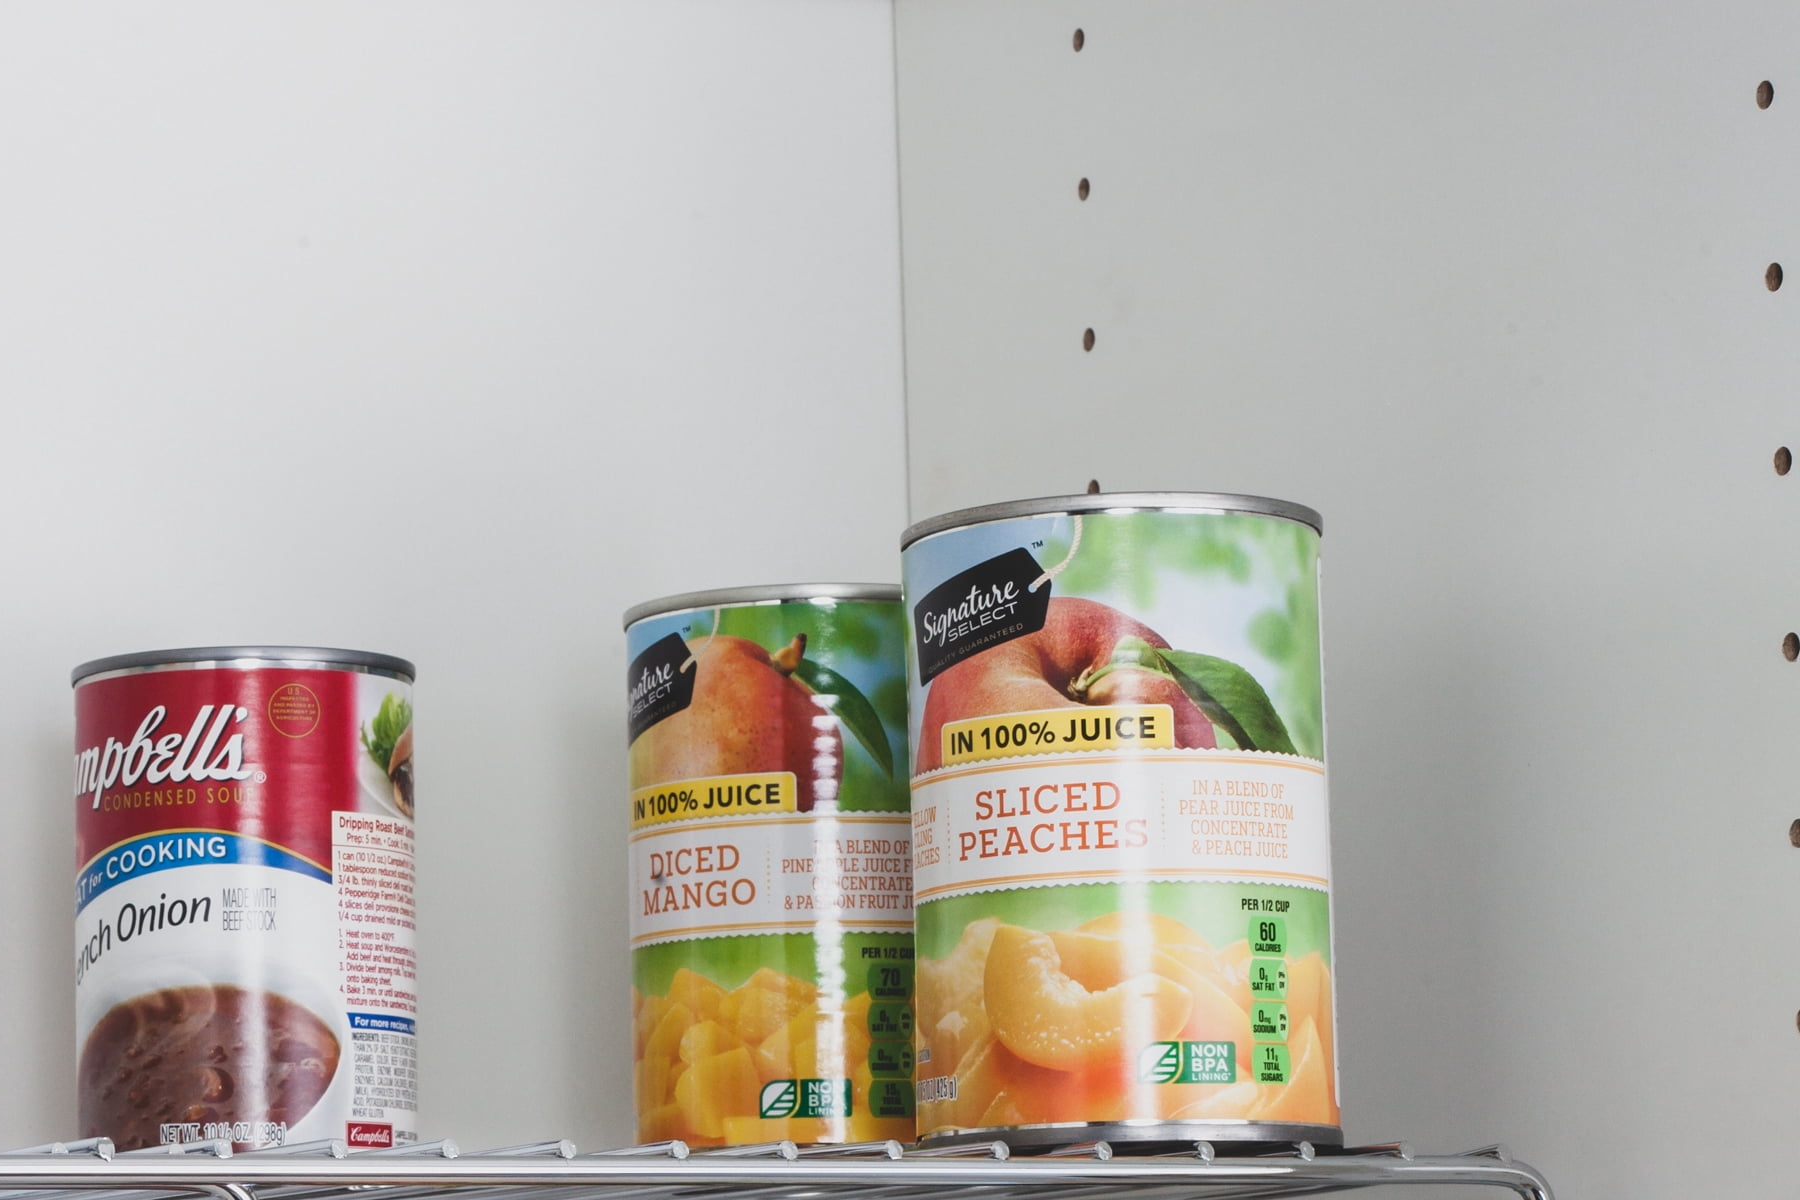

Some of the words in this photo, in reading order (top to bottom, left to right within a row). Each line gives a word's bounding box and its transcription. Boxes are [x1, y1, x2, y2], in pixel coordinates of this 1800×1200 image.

[923, 578, 1019, 648] Signature
[947, 602, 1018, 642] SELECT
[959, 623, 1024, 656] GUARANTEED
[950, 732, 974, 756] IN
[981, 721, 1055, 751] 100%
[1062, 716, 1156, 742] JUICE
[104, 789, 196, 811] CONDENSED
[634, 800, 646, 821] IN
[649, 790, 698, 815] 100%
[703, 783, 780, 809] JUICE
[975, 781, 1120, 821] SLICED
[1179, 799, 1219, 816] PEAR
[1222, 801, 1261, 818] JUICE
[1263, 803, 1294, 821] FROM
[339, 816, 373, 833] Dripping
[1191, 819, 1289, 840] CONCENTRATE
[846, 840, 891, 855] BLEND
[894, 840, 910, 855] OF
[959, 819, 1148, 861] PEACHES
[1206, 839, 1251, 857] PEACH
[1255, 841, 1289, 860] JUICE
[106, 837, 226, 880] COOKING
[649, 844, 740, 879] DICED
[222, 888, 249, 907] MADE
[254, 887, 277, 908] WITH
[643, 878, 756, 916] MANGO
[1241, 898, 1259, 911] PER
[1261, 900, 1273, 912] 1/2
[1275, 900, 1290, 913] CUP
[117, 893, 212, 943] Onion
[1259, 921, 1276, 942] 60
[1254, 942, 1282, 953] CALORIES
[1191, 1044, 1228, 1058] NON
[1191, 1058, 1228, 1072] BPA
